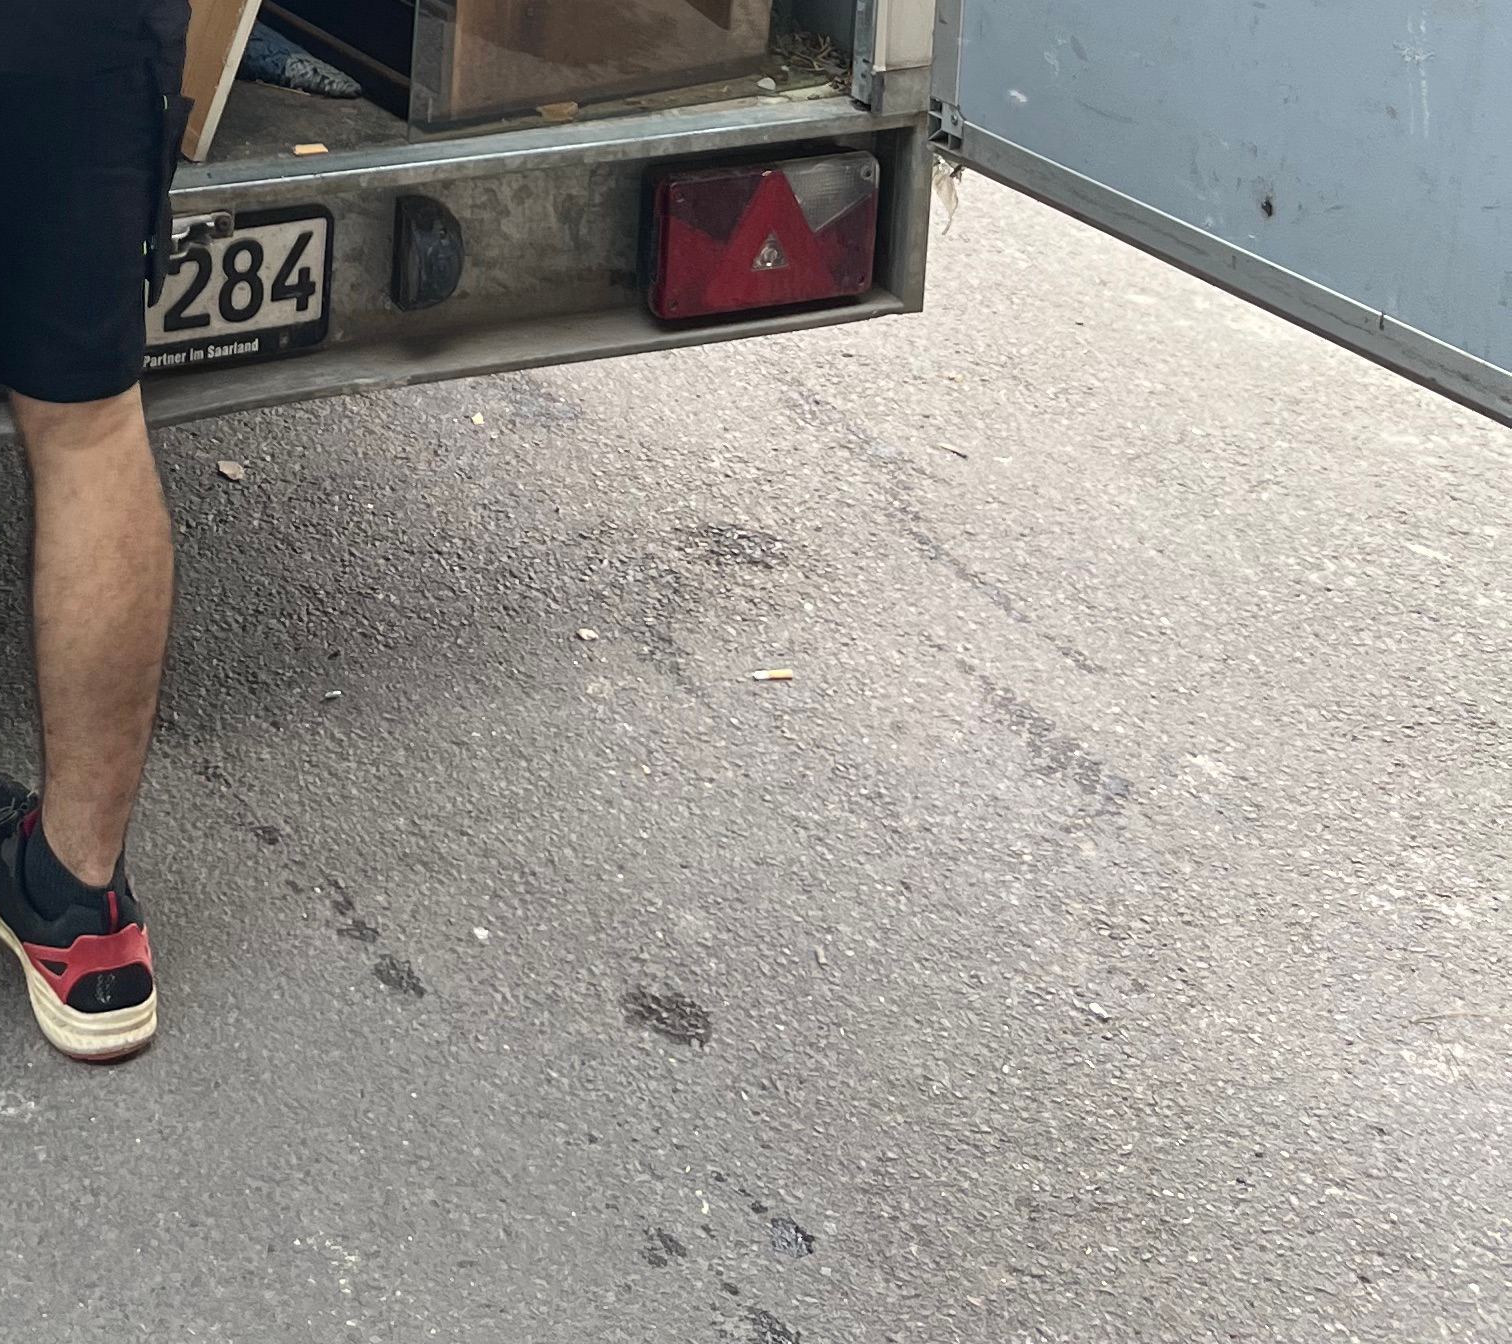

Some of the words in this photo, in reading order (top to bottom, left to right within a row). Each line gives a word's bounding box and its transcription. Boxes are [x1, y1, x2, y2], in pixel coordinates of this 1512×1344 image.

[163, 231, 316, 333] 284
[143, 351, 187, 368] Partner
[207, 337, 259, 359] Saarland
